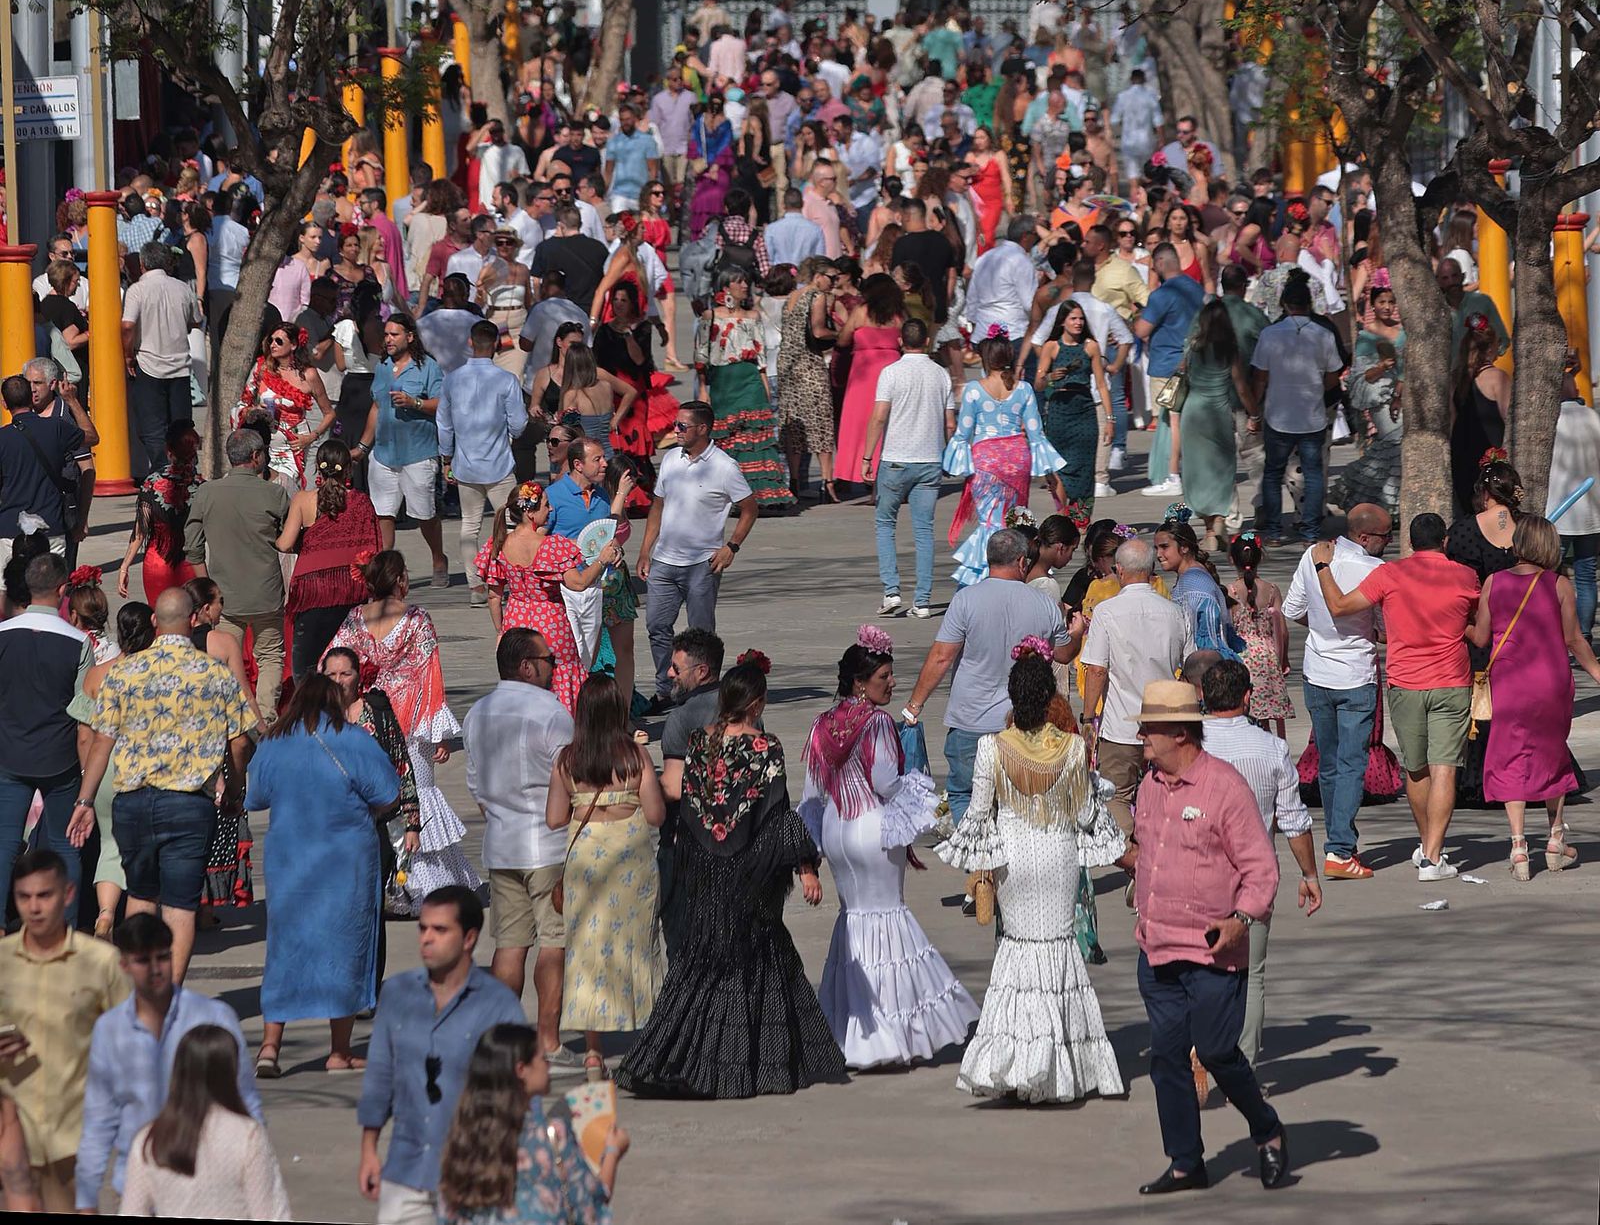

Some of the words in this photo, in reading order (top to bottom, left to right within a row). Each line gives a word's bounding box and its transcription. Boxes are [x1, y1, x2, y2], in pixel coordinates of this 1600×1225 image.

[17, 82, 53, 94] ENCIÓN
[30, 102, 76, 115] CABALLOS
[30, 127, 36, 136] A
